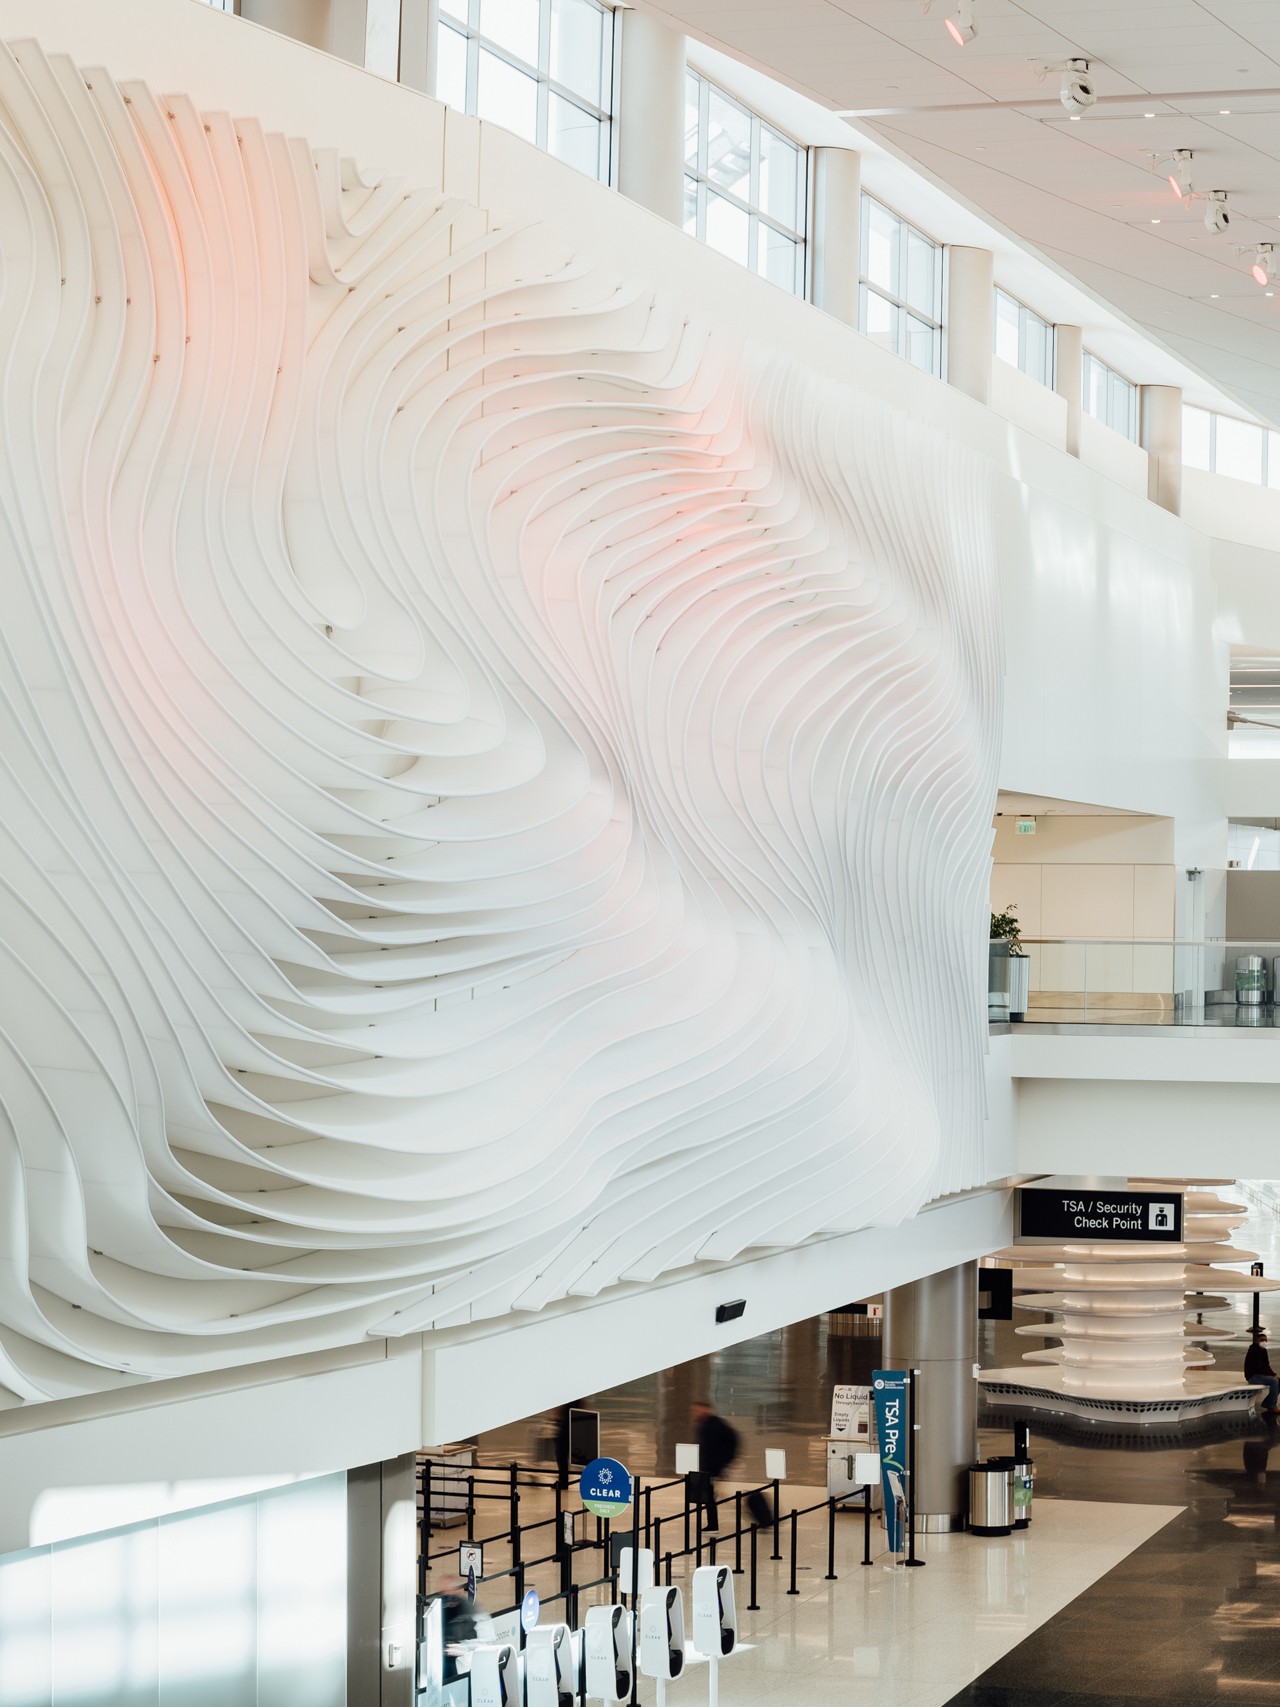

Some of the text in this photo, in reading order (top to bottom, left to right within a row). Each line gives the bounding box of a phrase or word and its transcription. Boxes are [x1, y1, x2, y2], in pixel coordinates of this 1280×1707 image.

[1062, 1200, 1143, 1216] TSA / Security
[1074, 1216, 1142, 1230] Check Point
[885, 1399, 899, 1453] TSA Pre
[590, 1488, 621, 1498] CLEAR
